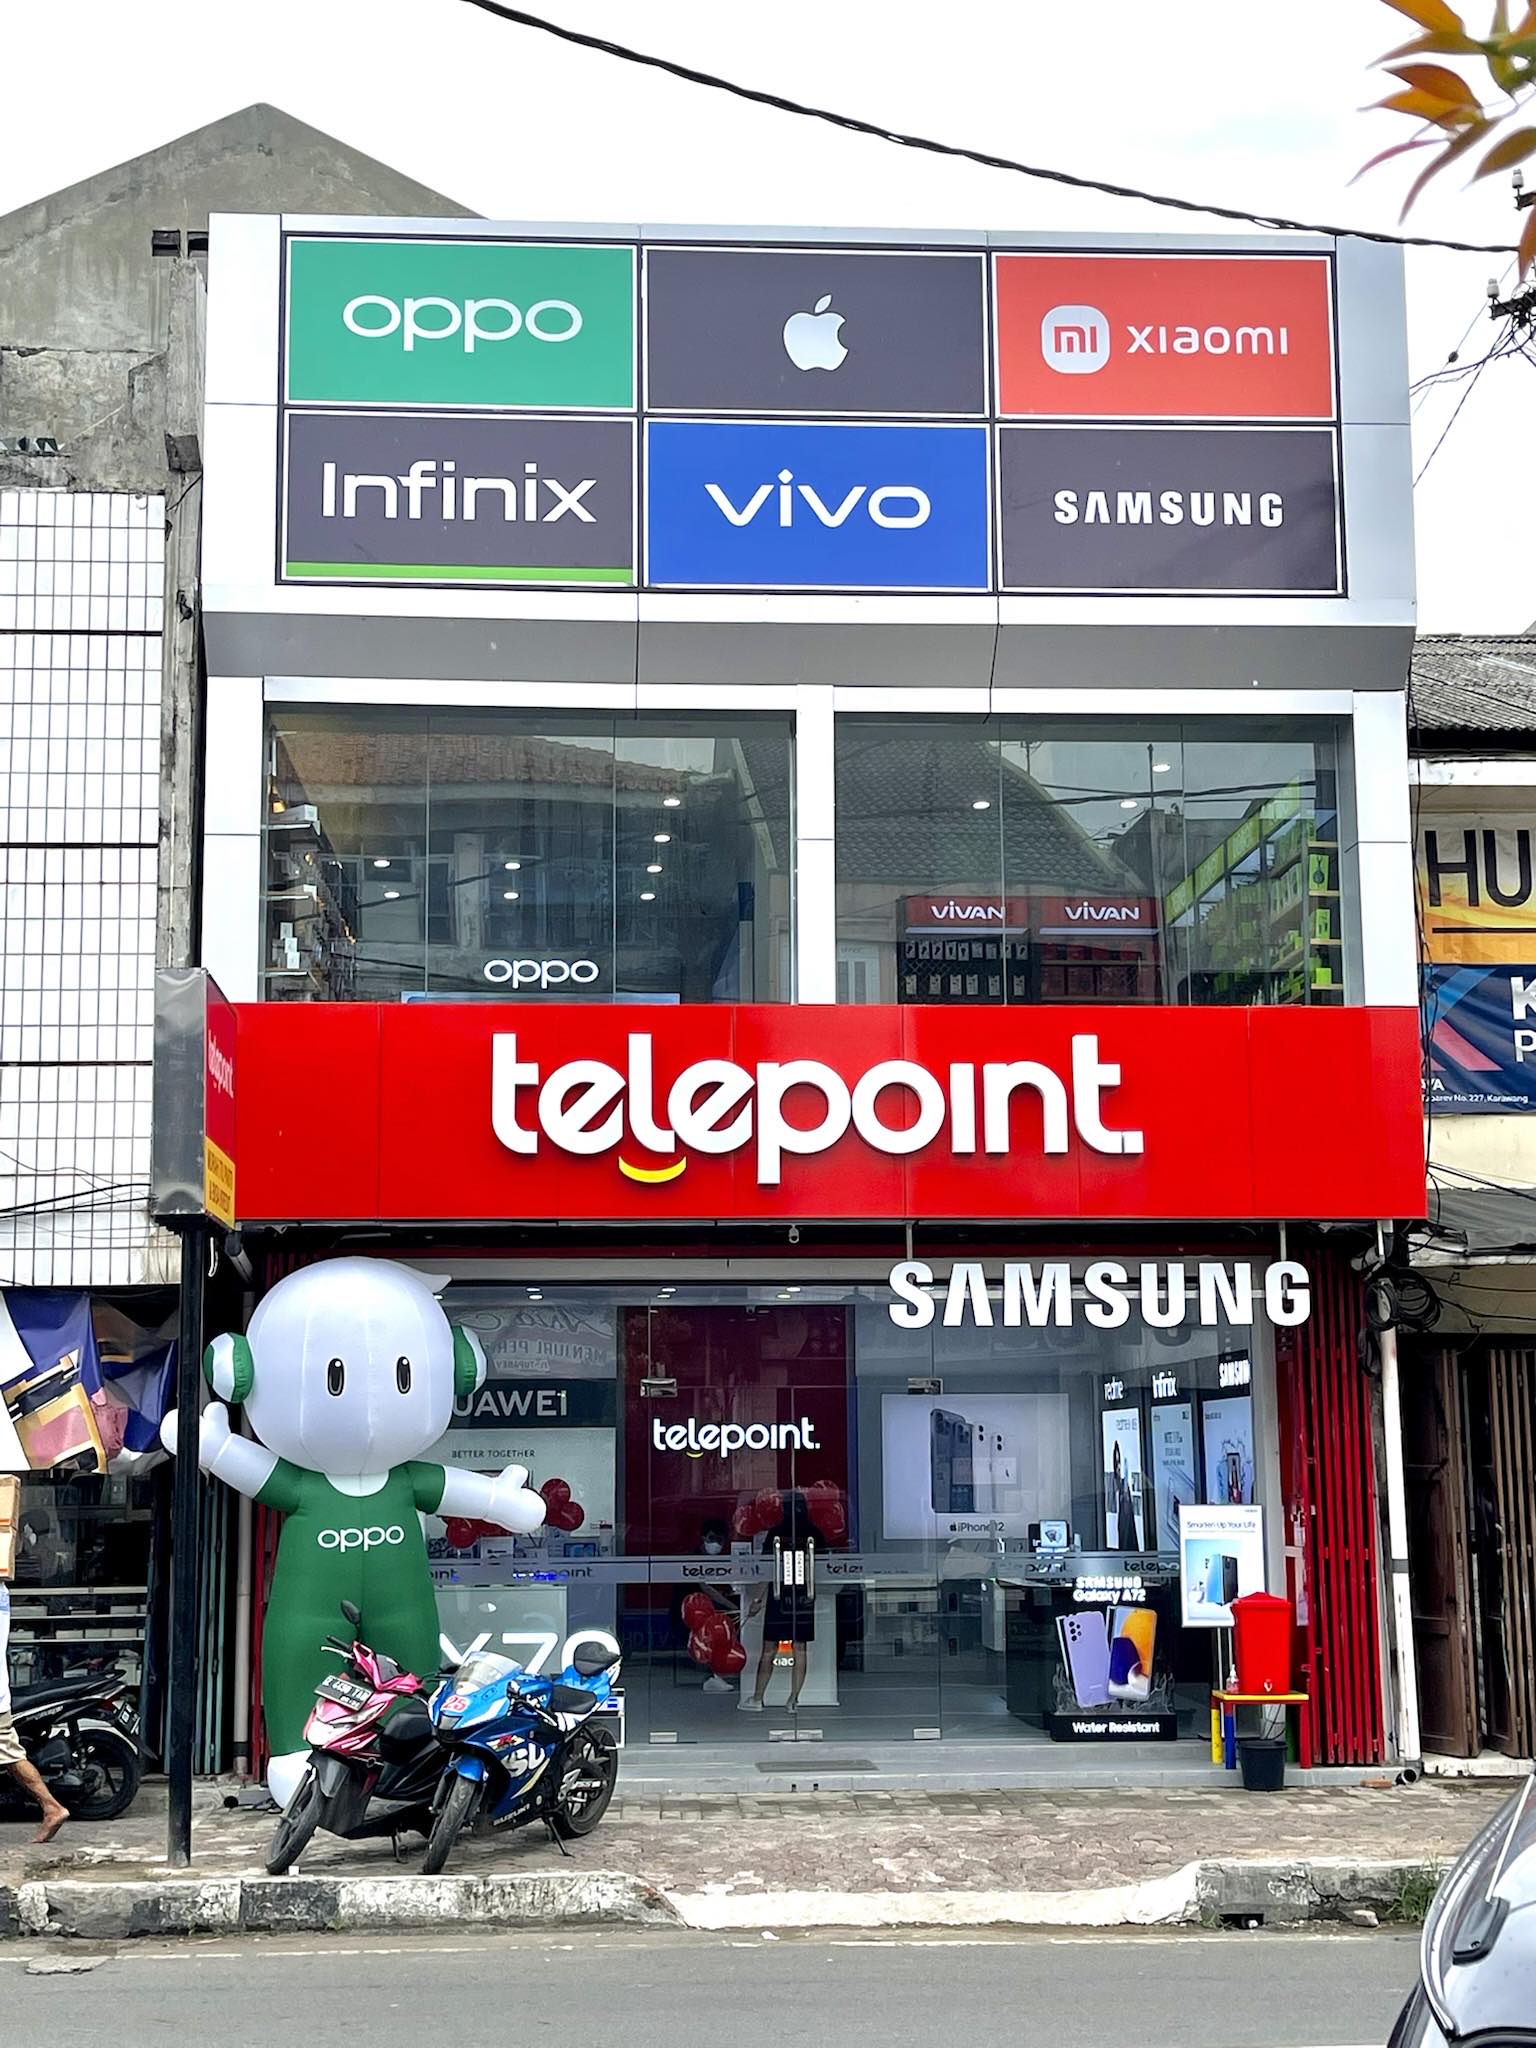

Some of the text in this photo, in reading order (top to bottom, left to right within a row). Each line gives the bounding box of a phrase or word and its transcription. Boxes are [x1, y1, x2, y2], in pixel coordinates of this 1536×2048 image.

[343, 295, 583, 352] oppo
[1127, 325, 1288, 355] xiaomi
[322, 460, 597, 524] Infinix
[704, 469, 931, 528] vivo
[1054, 490, 1284, 528] SAMSUNG
[484, 958, 599, 989] oppo
[889, 1261, 1311, 1328] SAMSUNG
[453, 1390, 567, 1417] UAWEI
[452, 1449, 536, 1459] BETTER TOGETHER
[317, 1525, 404, 1553] oppo
[1073, 1589, 1120, 1604] Galaxy
[1075, 1576, 1142, 1588] SAMSUNG
[443, 1695, 467, 1711] 25
[1072, 1721, 1160, 1734] Water Resistant
